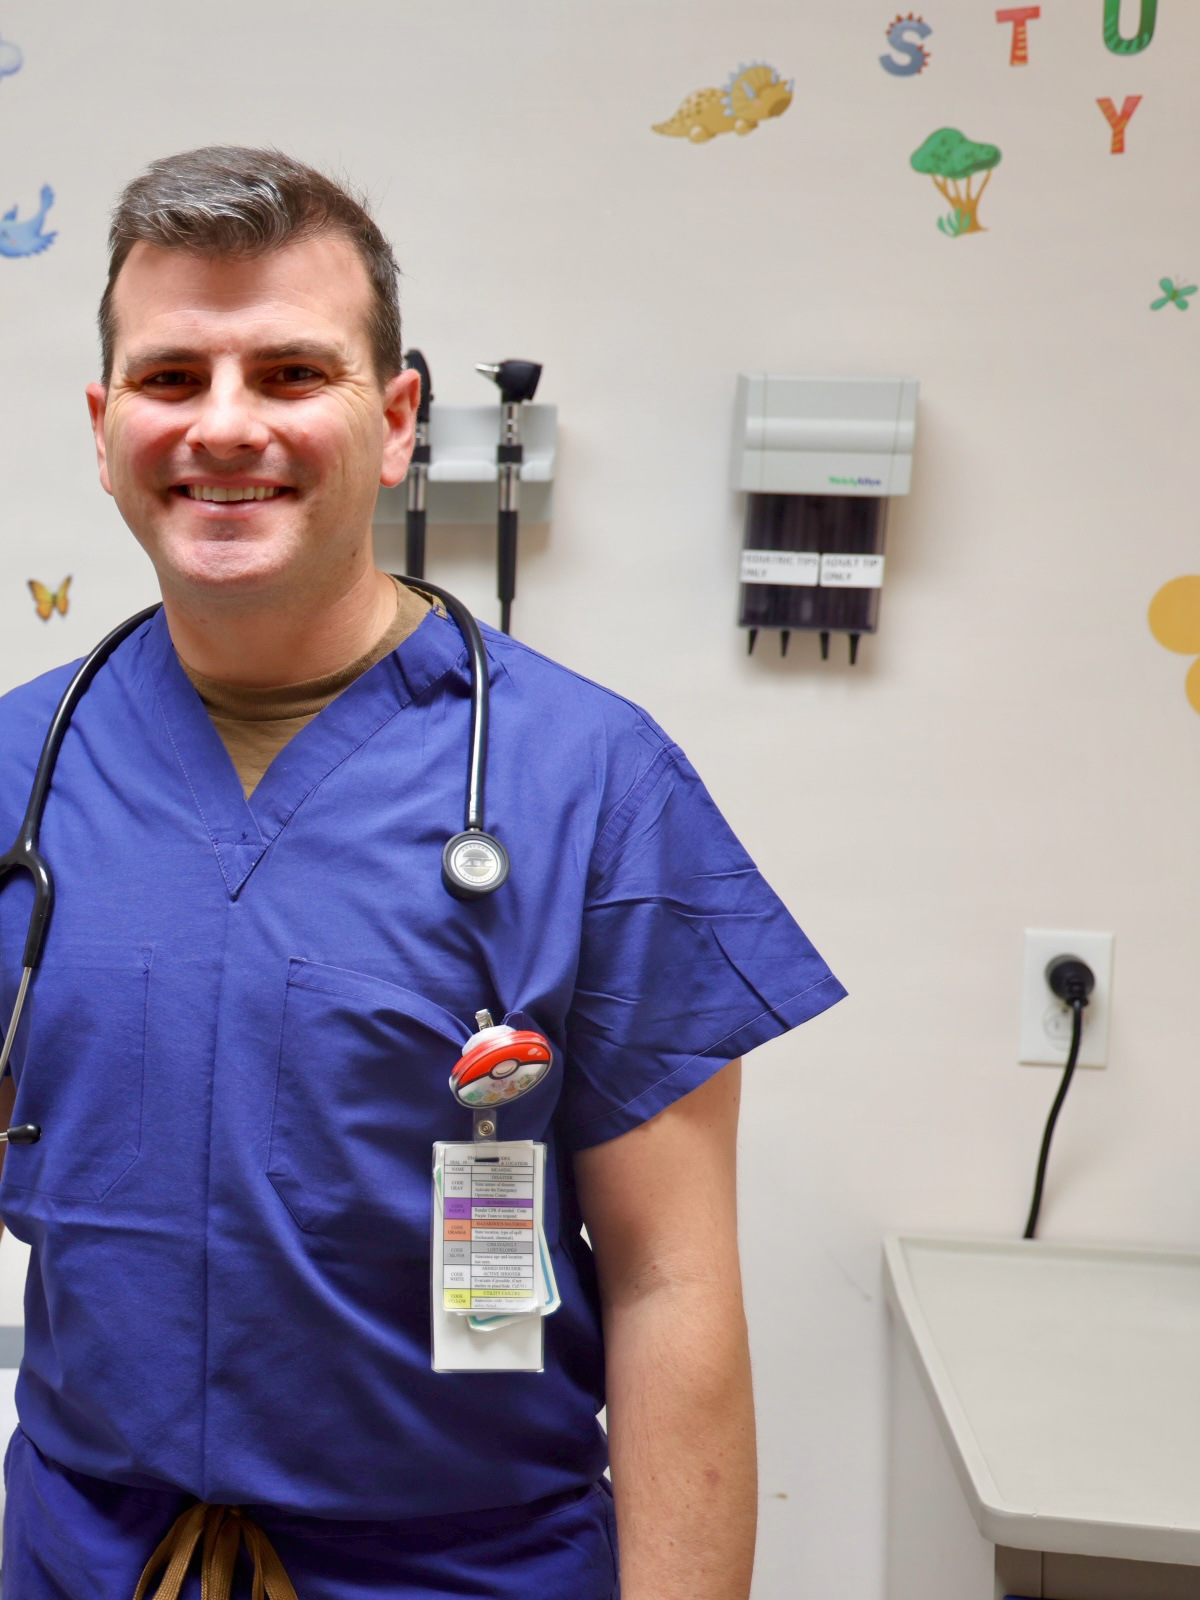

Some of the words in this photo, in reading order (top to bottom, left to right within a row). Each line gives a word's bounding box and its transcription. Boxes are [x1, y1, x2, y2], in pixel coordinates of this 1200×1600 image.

[879, 13, 933, 77] S
[996, 6, 1040, 66] T
[1103, 0, 1158, 55] U
[1096, 95, 1143, 154] Y
